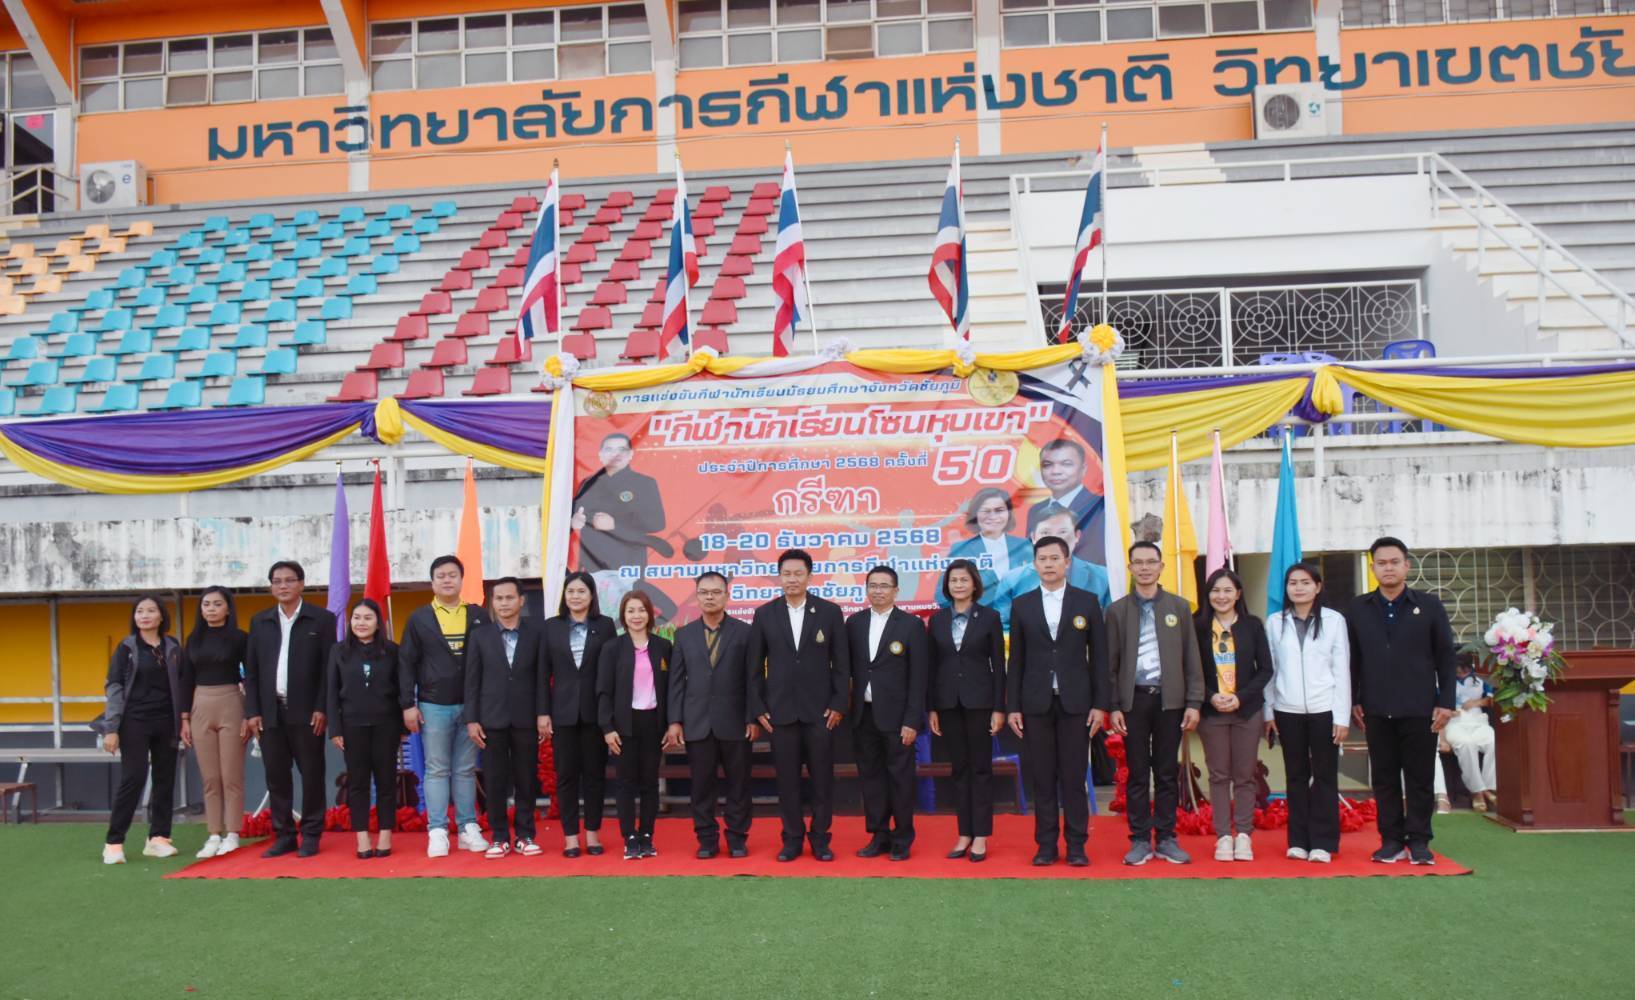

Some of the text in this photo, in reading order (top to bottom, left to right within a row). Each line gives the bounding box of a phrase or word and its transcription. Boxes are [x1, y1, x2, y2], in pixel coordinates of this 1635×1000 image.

[208, 53, 1173, 161] มหาวิทยาลัยการกีฬาแห่งชาติ
[697, 446, 1017, 485] ประจำปีการศึกษา 2568 ครั้งที่ 50
[773, 474, 881, 517] กรีฑา
[700, 528, 941, 552] 18-20 ธันวาคม 2568
[619, 564, 641, 579] ณ
